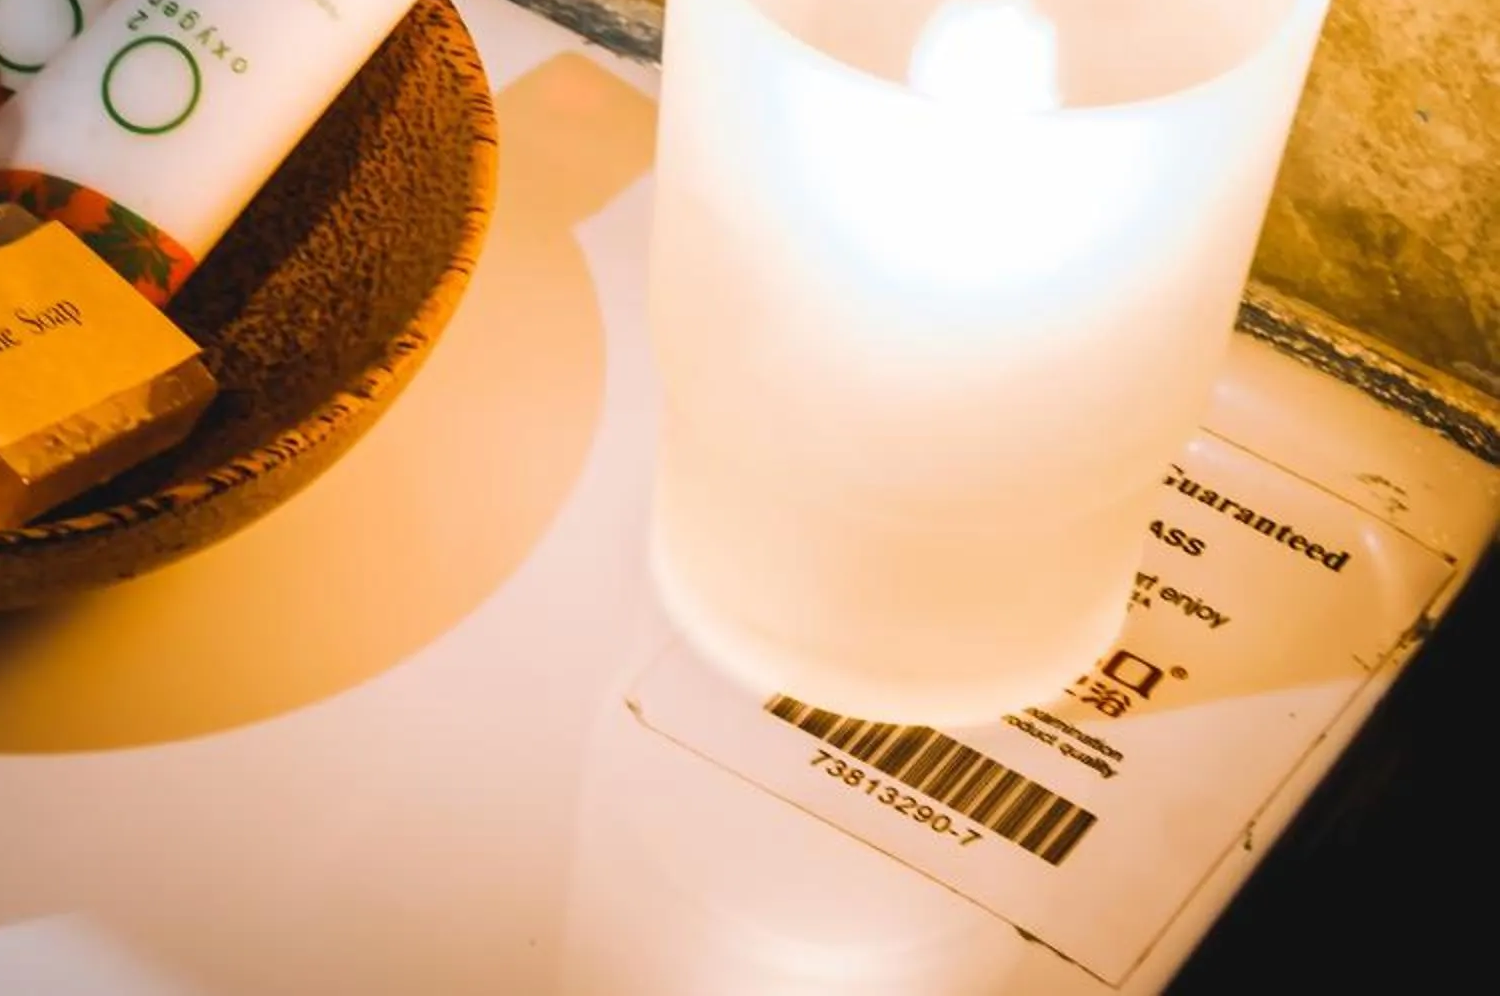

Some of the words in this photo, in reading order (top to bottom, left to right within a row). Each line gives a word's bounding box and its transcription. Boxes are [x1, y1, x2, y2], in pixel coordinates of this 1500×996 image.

[14, 299, 83, 335] Soap
[1159, 586, 1231, 630] enjoy
[1059, 742, 1120, 780] quality
[809, 748, 984, 847] 73813290-7
